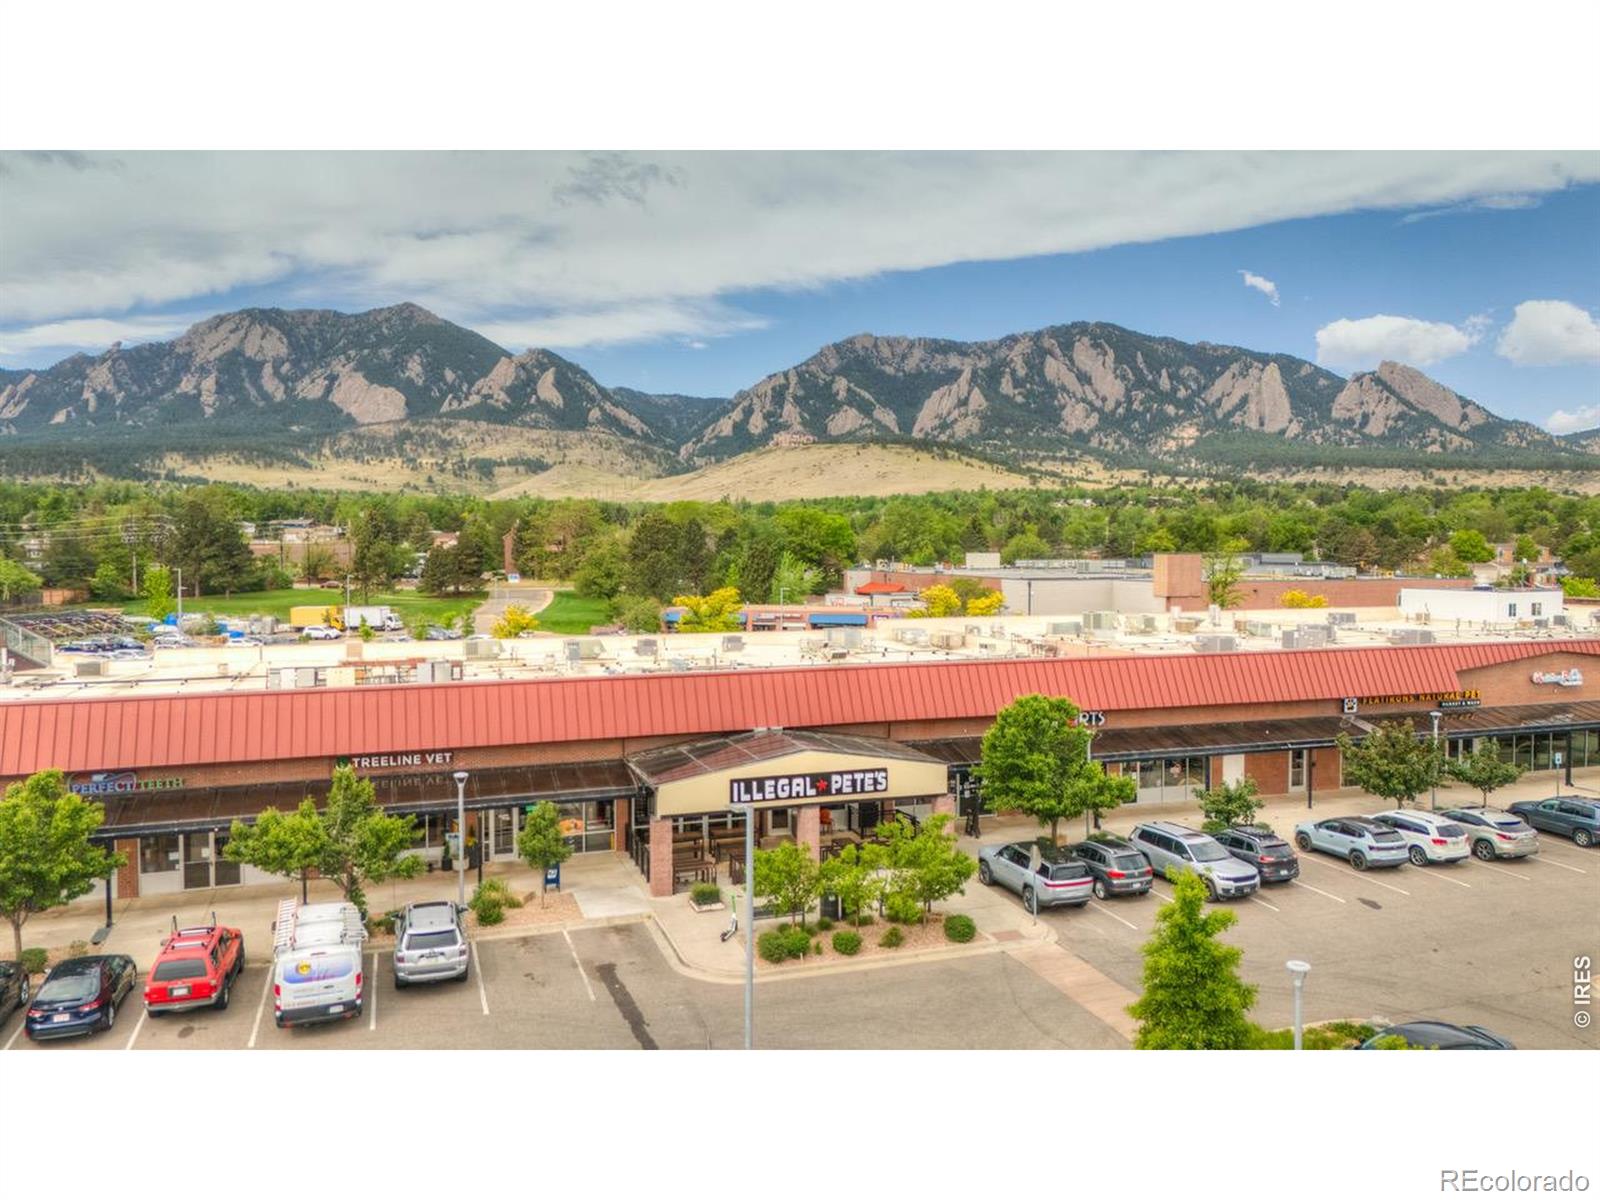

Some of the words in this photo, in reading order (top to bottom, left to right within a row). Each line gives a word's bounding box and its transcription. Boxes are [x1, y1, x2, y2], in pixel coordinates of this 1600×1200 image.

[352, 754, 422, 768] TREELINE
[426, 752, 453, 764] VET
[71, 780, 133, 794] PERFECT
[138, 778, 184, 791] TEETH
[732, 776, 817, 802] ILLEGAL
[830, 771, 887, 794] PETE'S
